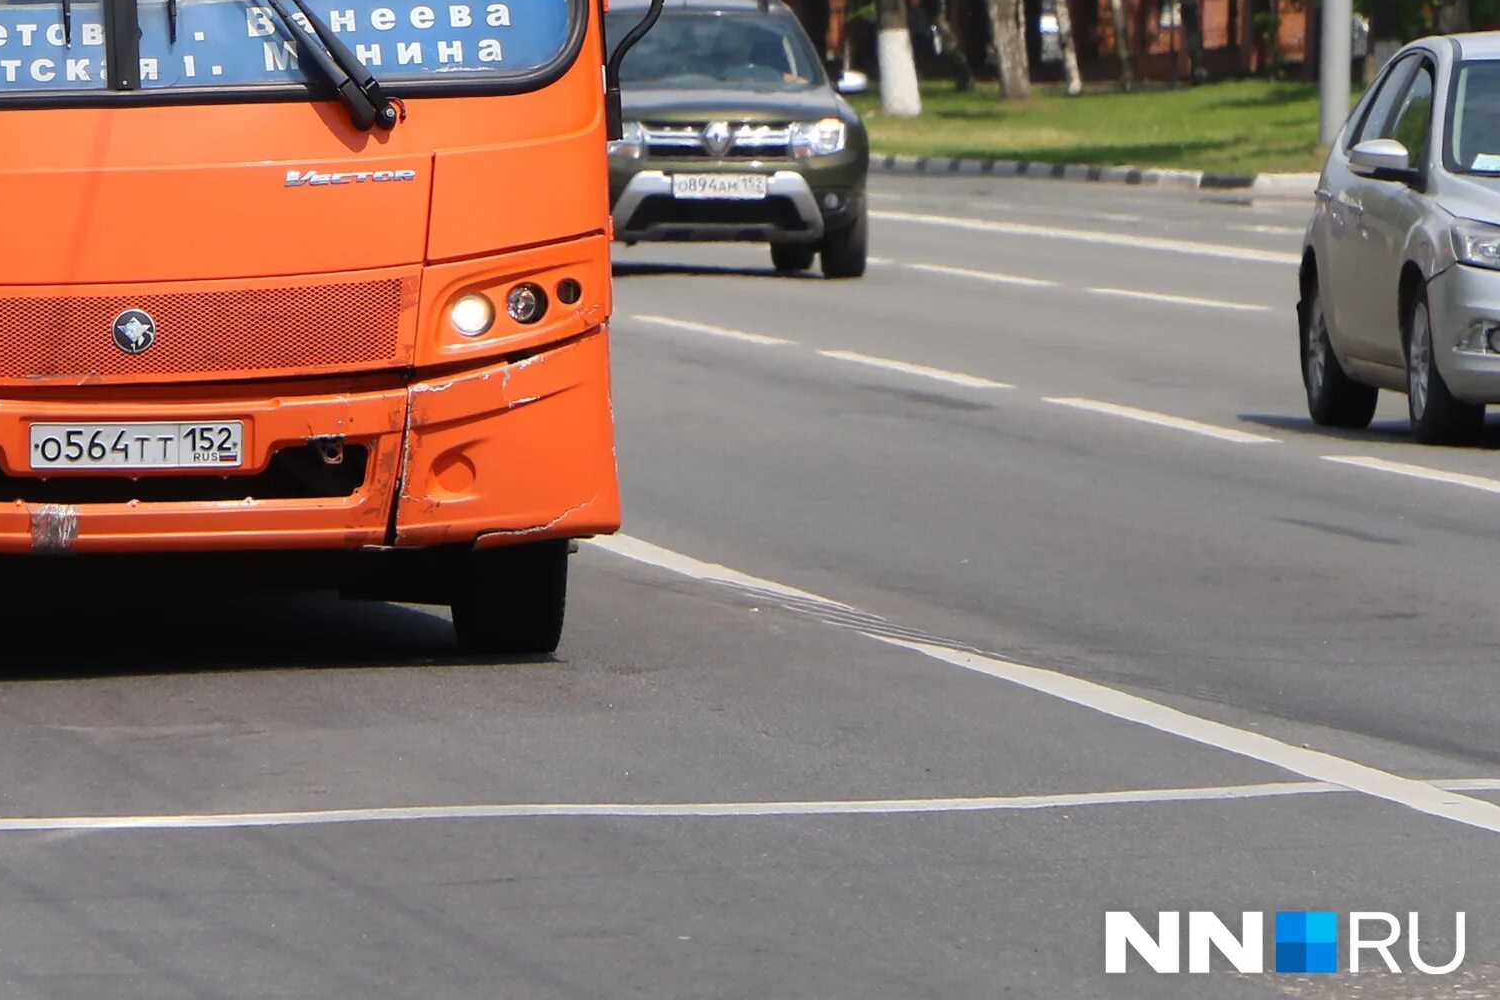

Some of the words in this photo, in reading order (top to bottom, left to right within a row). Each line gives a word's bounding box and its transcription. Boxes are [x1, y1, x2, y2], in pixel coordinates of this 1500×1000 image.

[262, 37, 503, 72] Мнина
[40, 429, 174, 462] О564ТТ
[182, 426, 233, 452] 152
[193, 452, 219, 463] RUS
